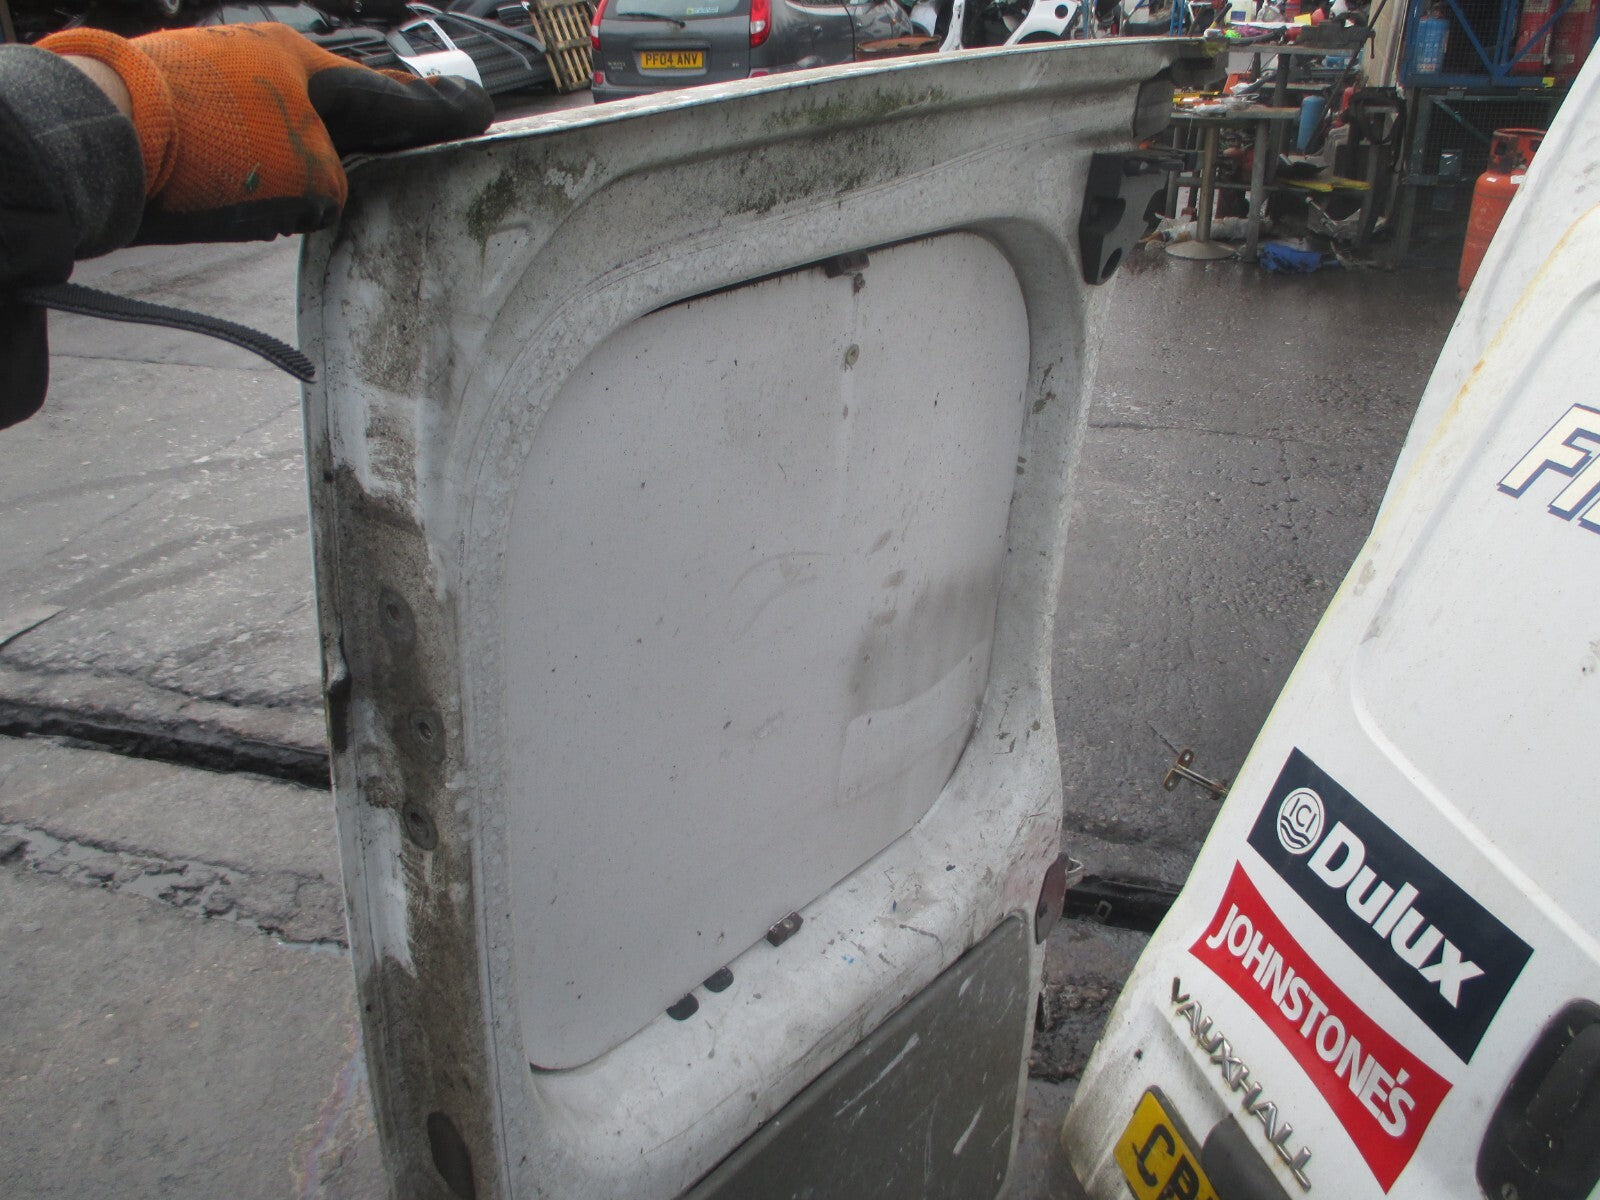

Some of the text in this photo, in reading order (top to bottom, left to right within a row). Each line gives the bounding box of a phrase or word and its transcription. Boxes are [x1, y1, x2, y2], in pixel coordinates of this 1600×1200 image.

[645, 50, 699, 66] PF04 ANV
[1289, 797, 1485, 1008] ICI Dulux
[1170, 976, 1312, 1191] VAUXHALL
[1205, 903, 1416, 1137] JOHNSTONE'S
